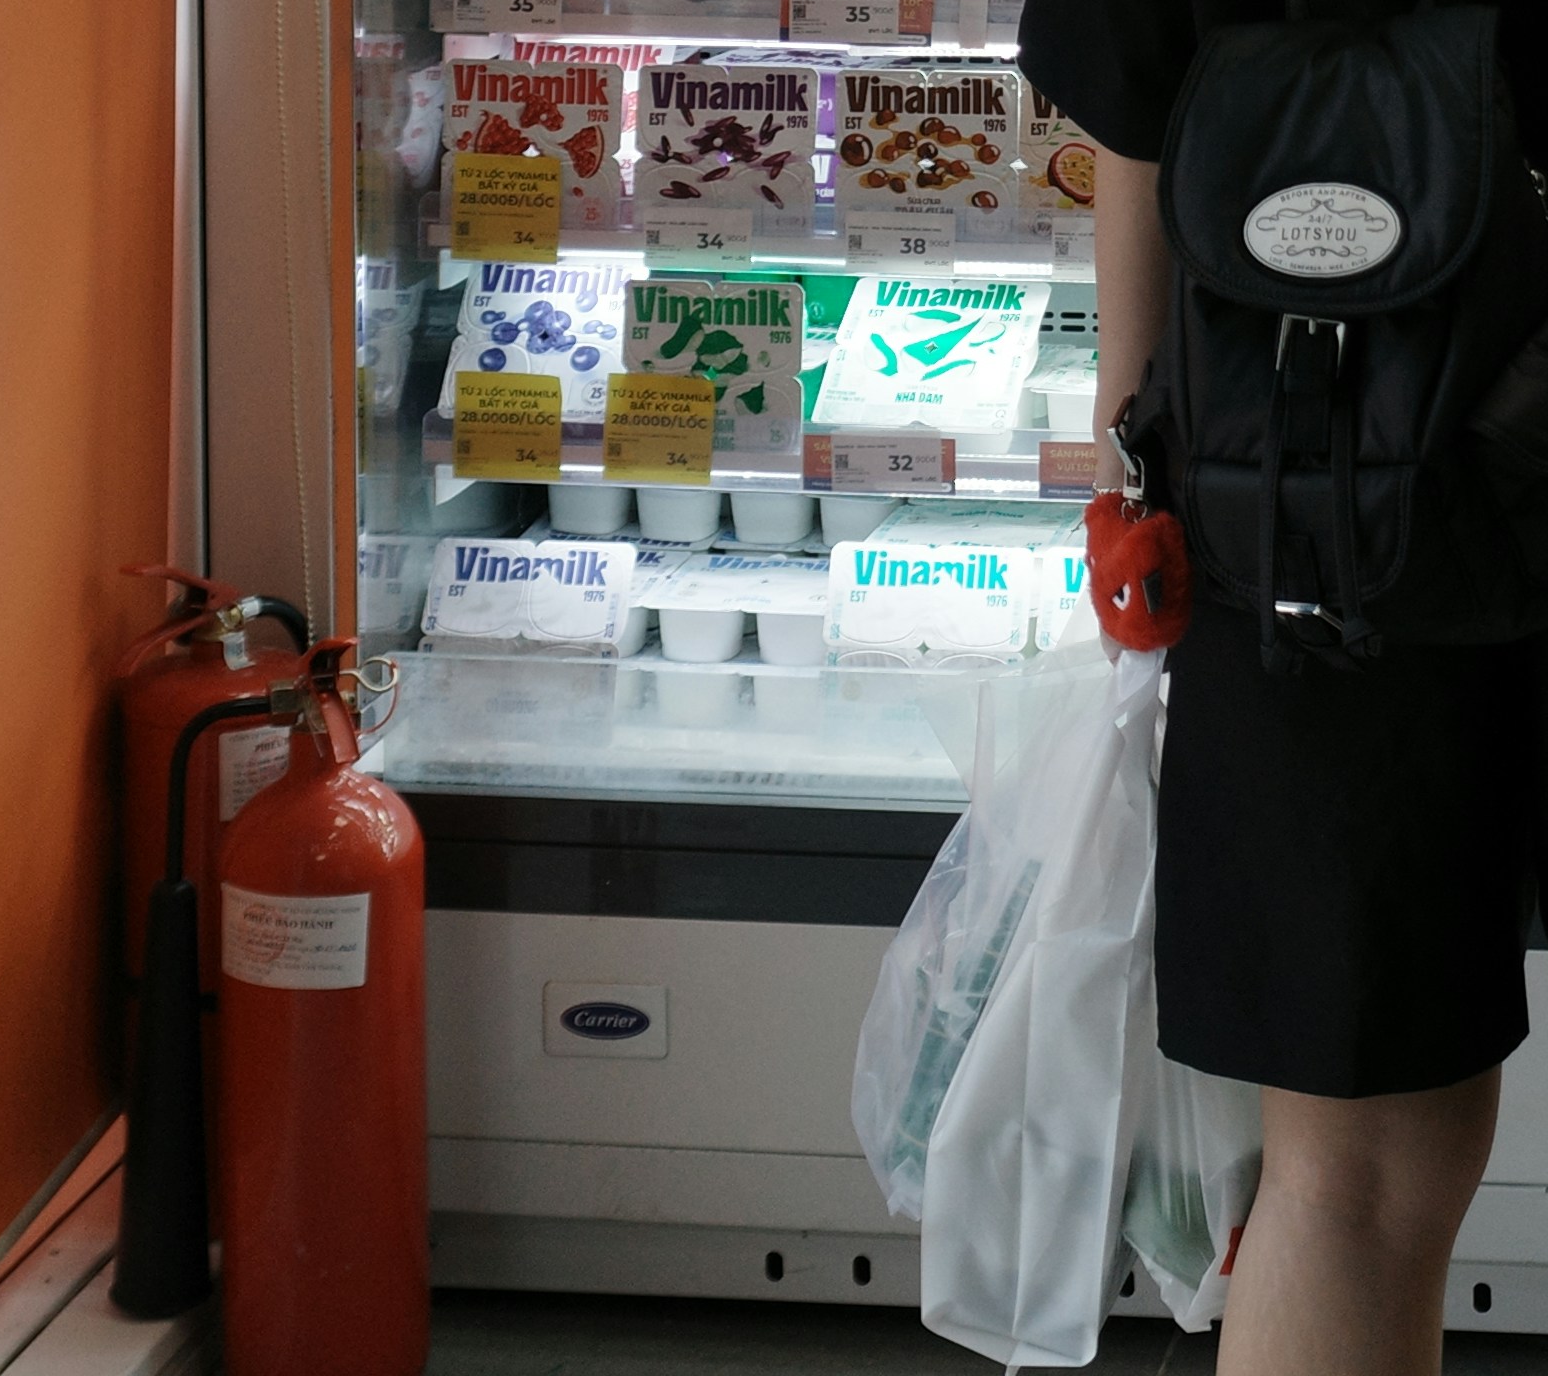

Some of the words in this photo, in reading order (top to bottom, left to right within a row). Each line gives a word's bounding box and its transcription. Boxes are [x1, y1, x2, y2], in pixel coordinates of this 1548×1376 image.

[845, 7, 870, 23] 35
[453, 66, 609, 105] Vinamilk
[651, 74, 808, 110] Vinamilk
[1281, 227, 1357, 242] LOTSYOU
[901, 238, 926, 255] 38
[876, 281, 1025, 310] Vinamilk
[889, 455, 913, 470] 32
[455, 549, 607, 585] Vinamilk
[854, 551, 1008, 588] Vinamilk
[574, 1011, 636, 1028] Carrier
